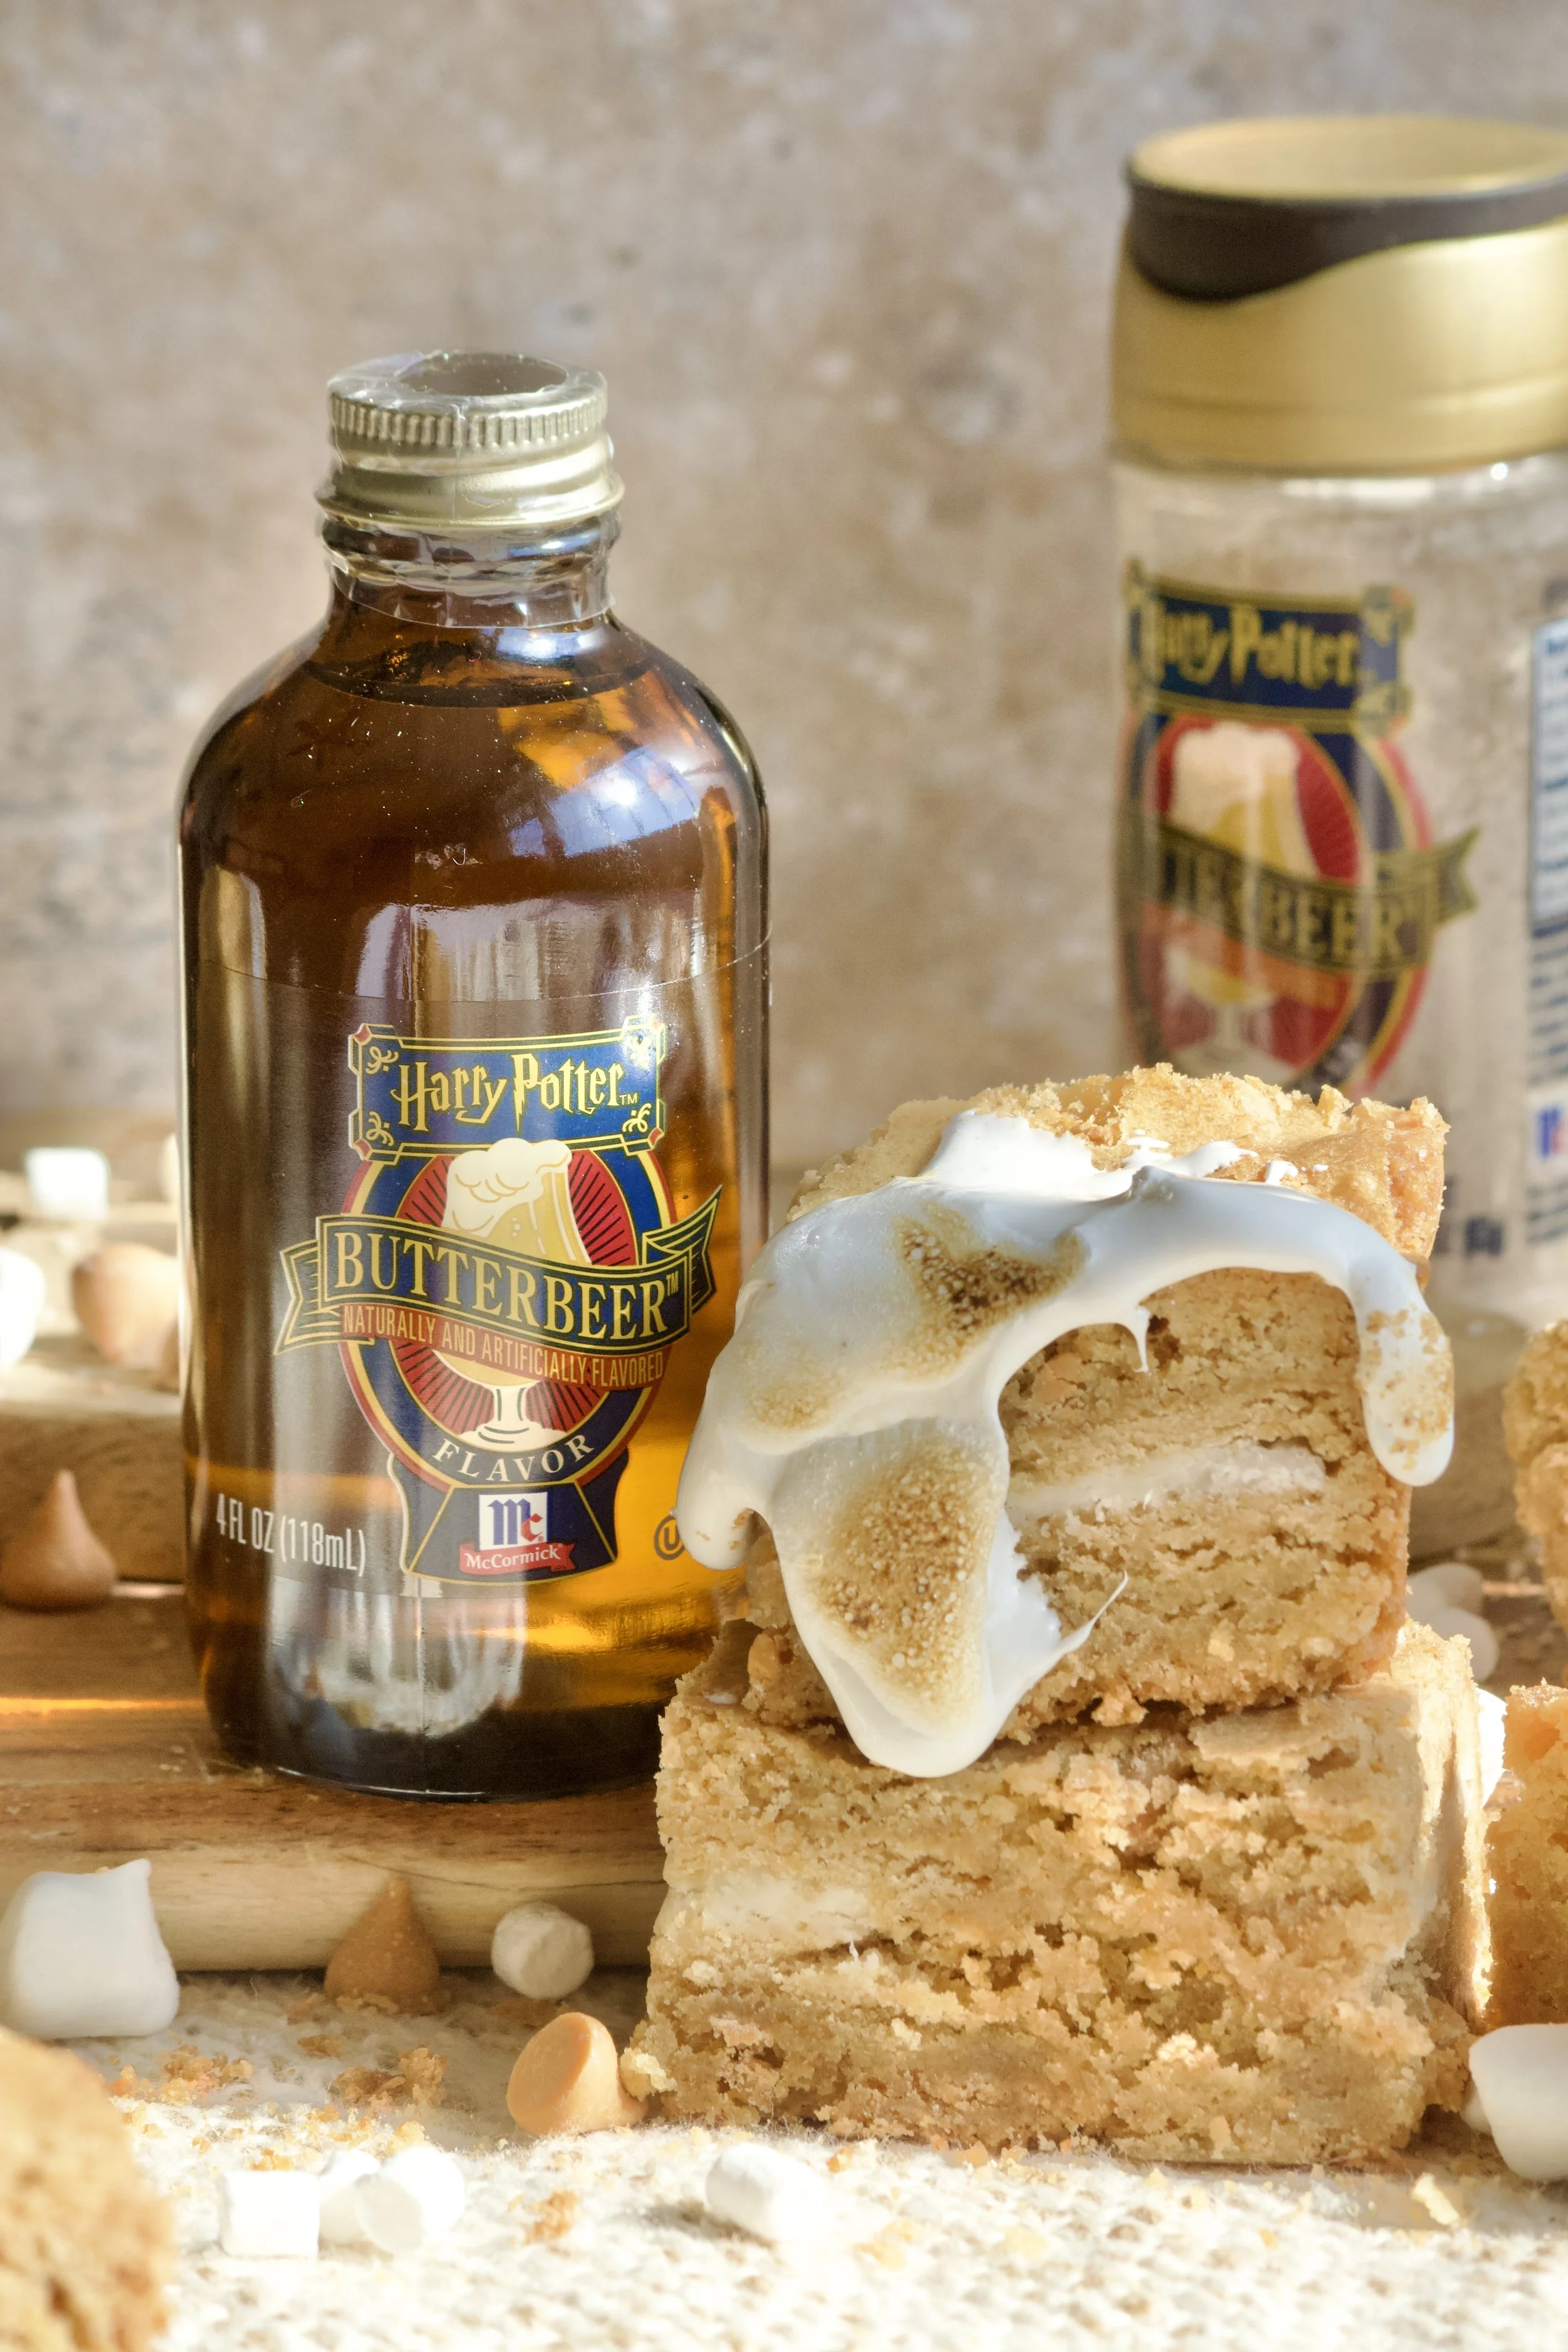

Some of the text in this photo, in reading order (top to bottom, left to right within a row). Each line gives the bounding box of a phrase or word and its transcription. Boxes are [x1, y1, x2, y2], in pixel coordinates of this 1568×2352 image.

[390, 1062, 507, 1131] Harry
[511, 1054, 623, 1131] Potter
[334, 1232, 668, 1340] BUTTERBEER
[344, 1305, 663, 1387] NATURALLY AND ARTIFICIALLY FLAVORED
[432, 1434, 594, 1481] FLAVOR
[252, 1507, 274, 1554] OZ
[464, 1545, 561, 1569] McCormick
